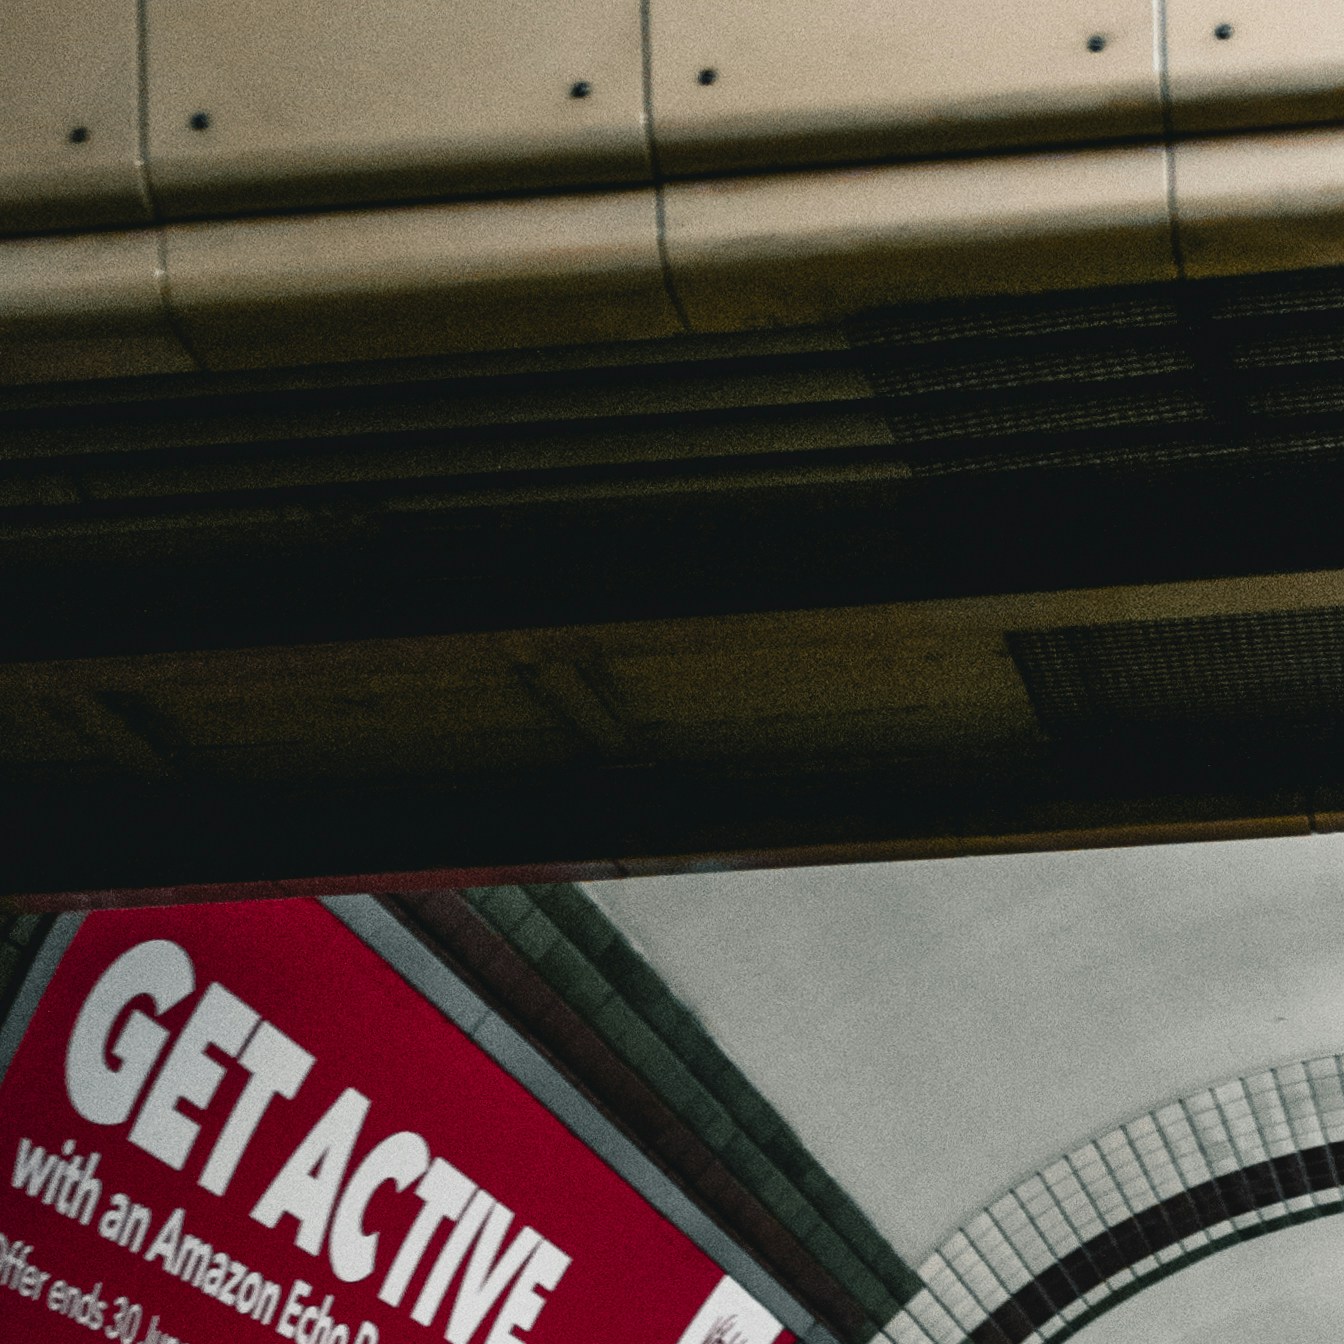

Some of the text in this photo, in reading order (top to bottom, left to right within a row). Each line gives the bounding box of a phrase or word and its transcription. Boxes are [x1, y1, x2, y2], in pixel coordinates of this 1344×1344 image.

[65, 939, 317, 1197] GET
[11, 1137, 102, 1226] with
[98, 1193, 152, 1254] an
[144, 1207, 282, 1326] Amazon
[48, 1280, 108, 1330] ends
[105, 1297, 143, 1344] 30
